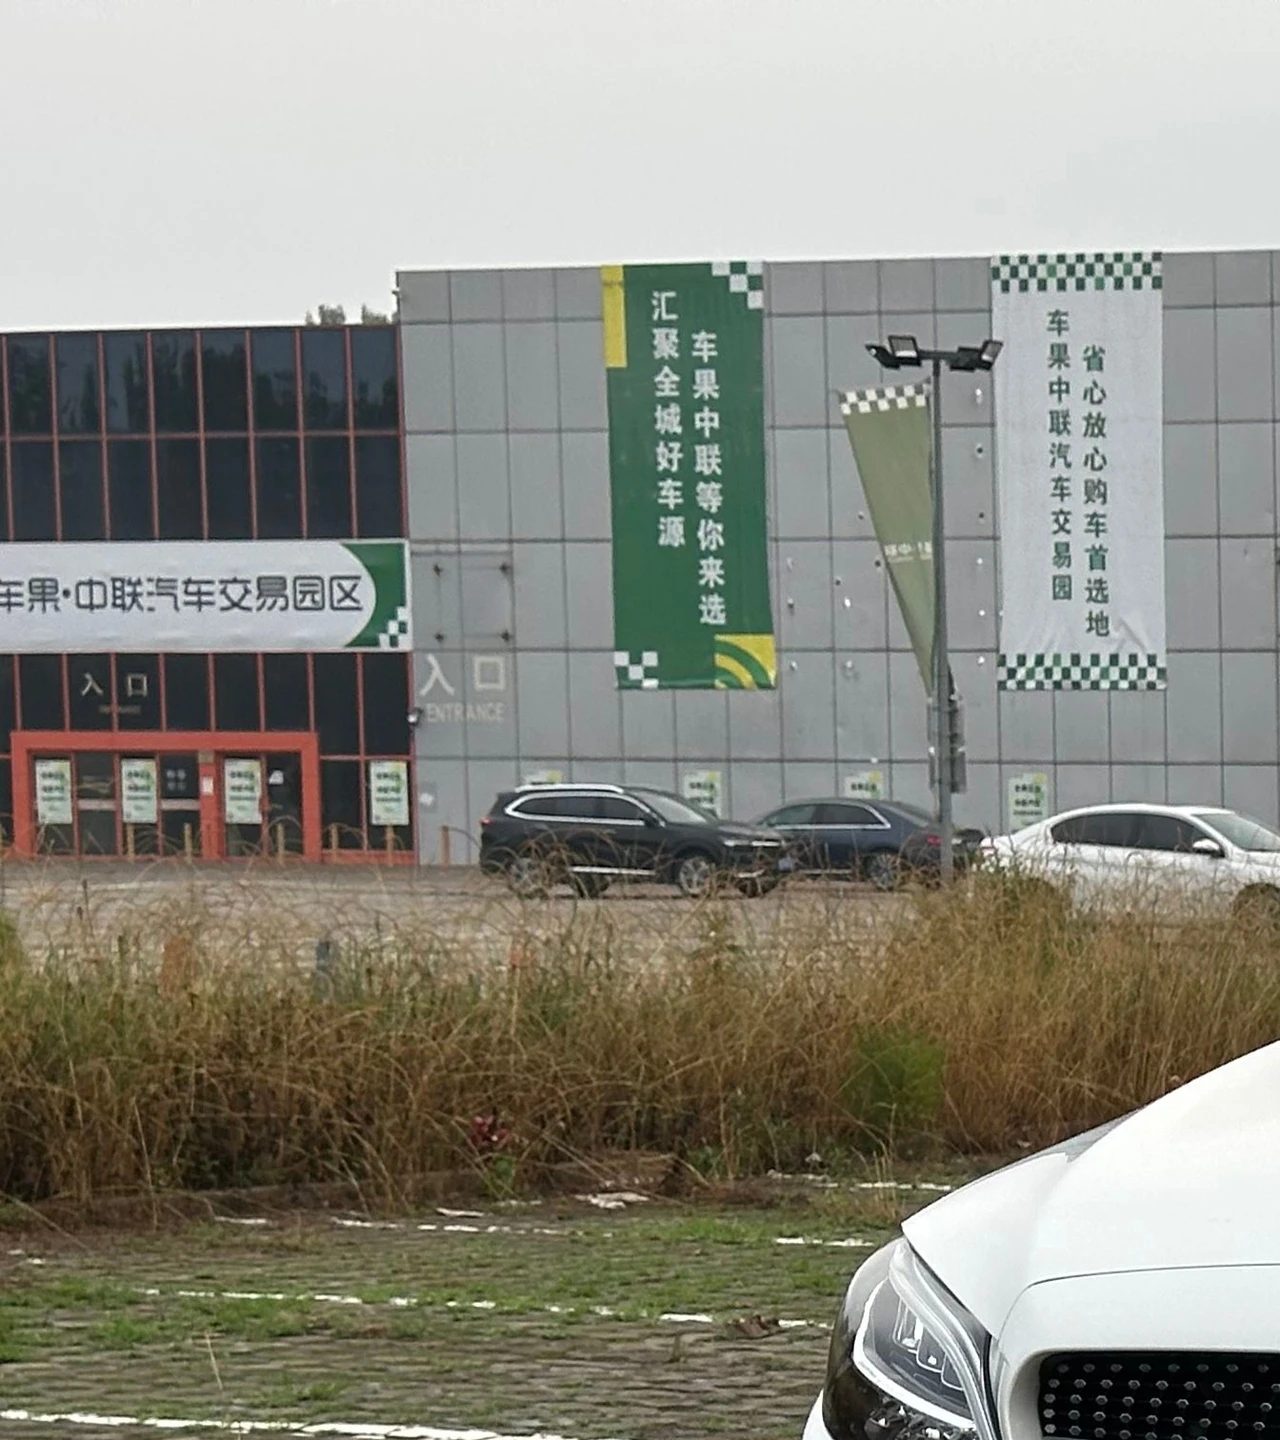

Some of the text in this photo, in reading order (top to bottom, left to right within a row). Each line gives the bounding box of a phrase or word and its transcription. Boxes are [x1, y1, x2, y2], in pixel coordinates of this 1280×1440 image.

[651, 290, 686, 548] 汇聚全城好车源
[692, 331, 727, 625] 车果中联等你来选
[1047, 309, 1072, 601] 车果中联汽车交易园
[1082, 344, 1110, 638] 省心放心购车首选地
[81, 672, 148, 697] 入口
[420, 653, 505, 696] 入口
